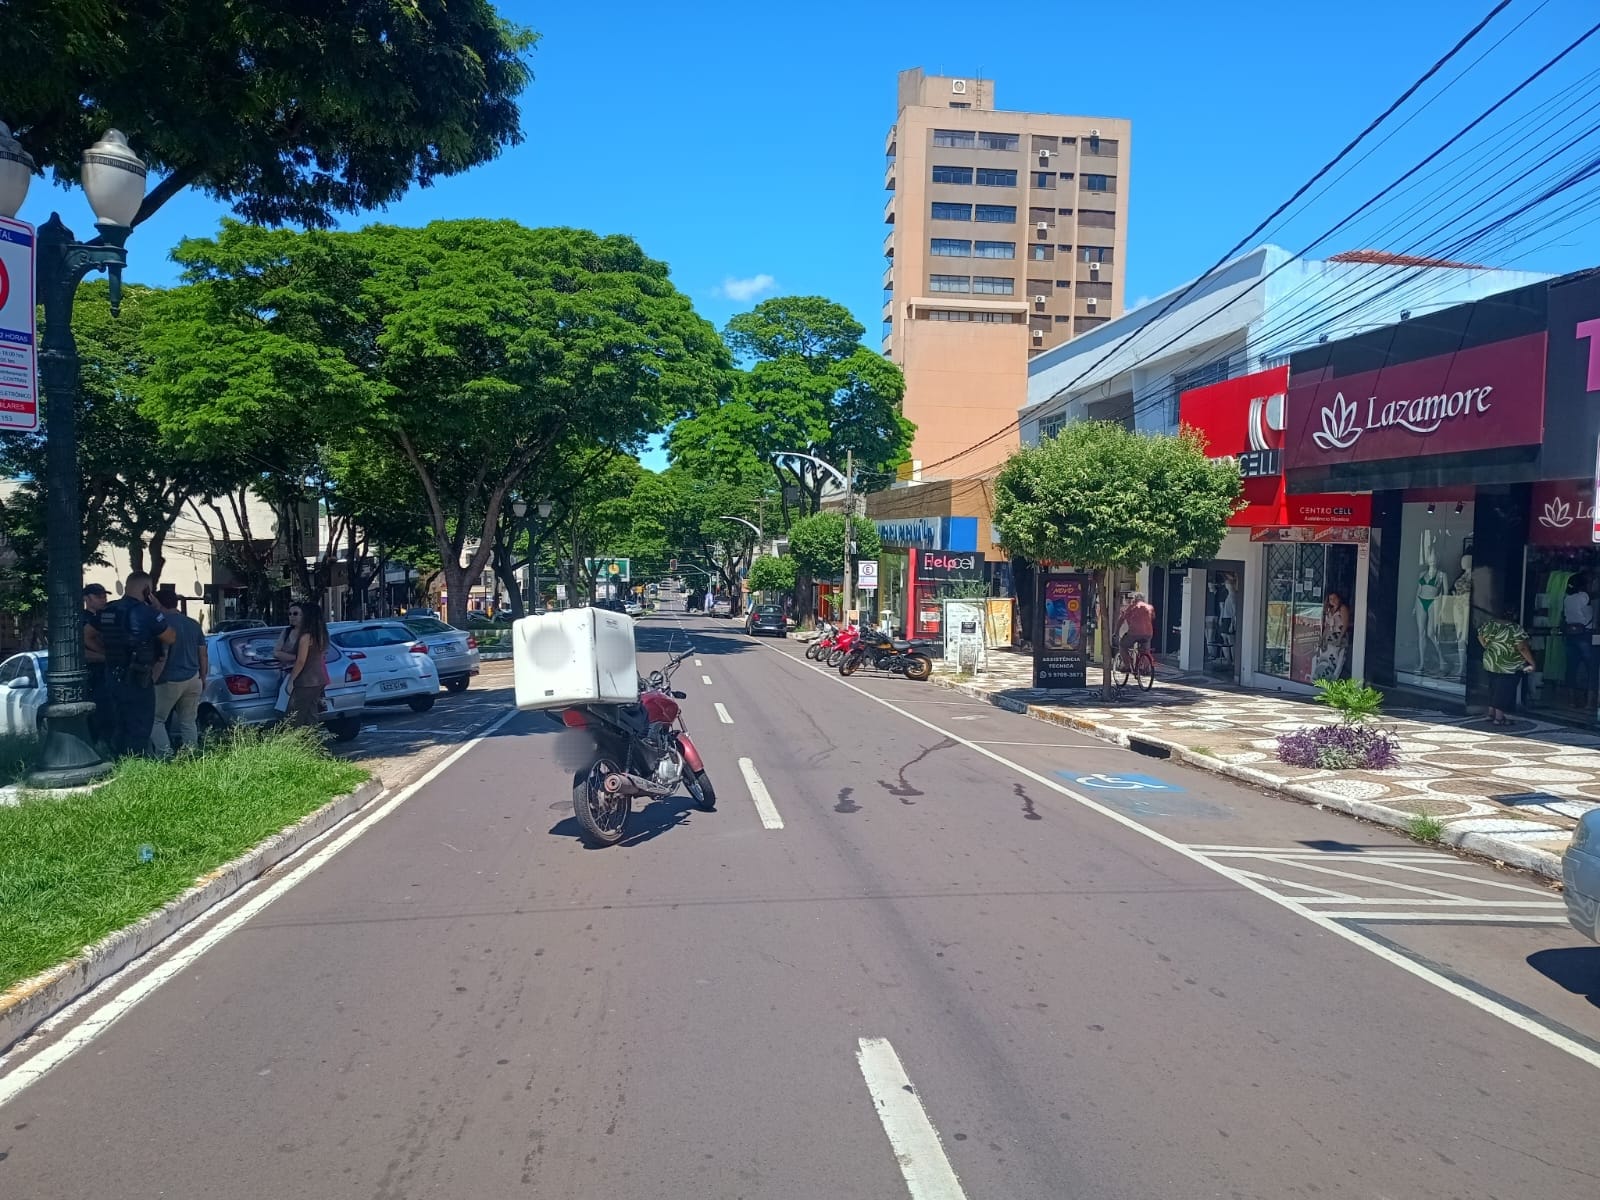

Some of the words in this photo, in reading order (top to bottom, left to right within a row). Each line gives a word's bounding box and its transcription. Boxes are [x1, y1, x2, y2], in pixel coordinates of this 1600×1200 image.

[5, 333, 28, 343] HORAS
[1366, 385, 1493, 433] Lazamore
[1238, 453, 1275, 477] CELL
[1333, 507, 1352, 515] CELL
